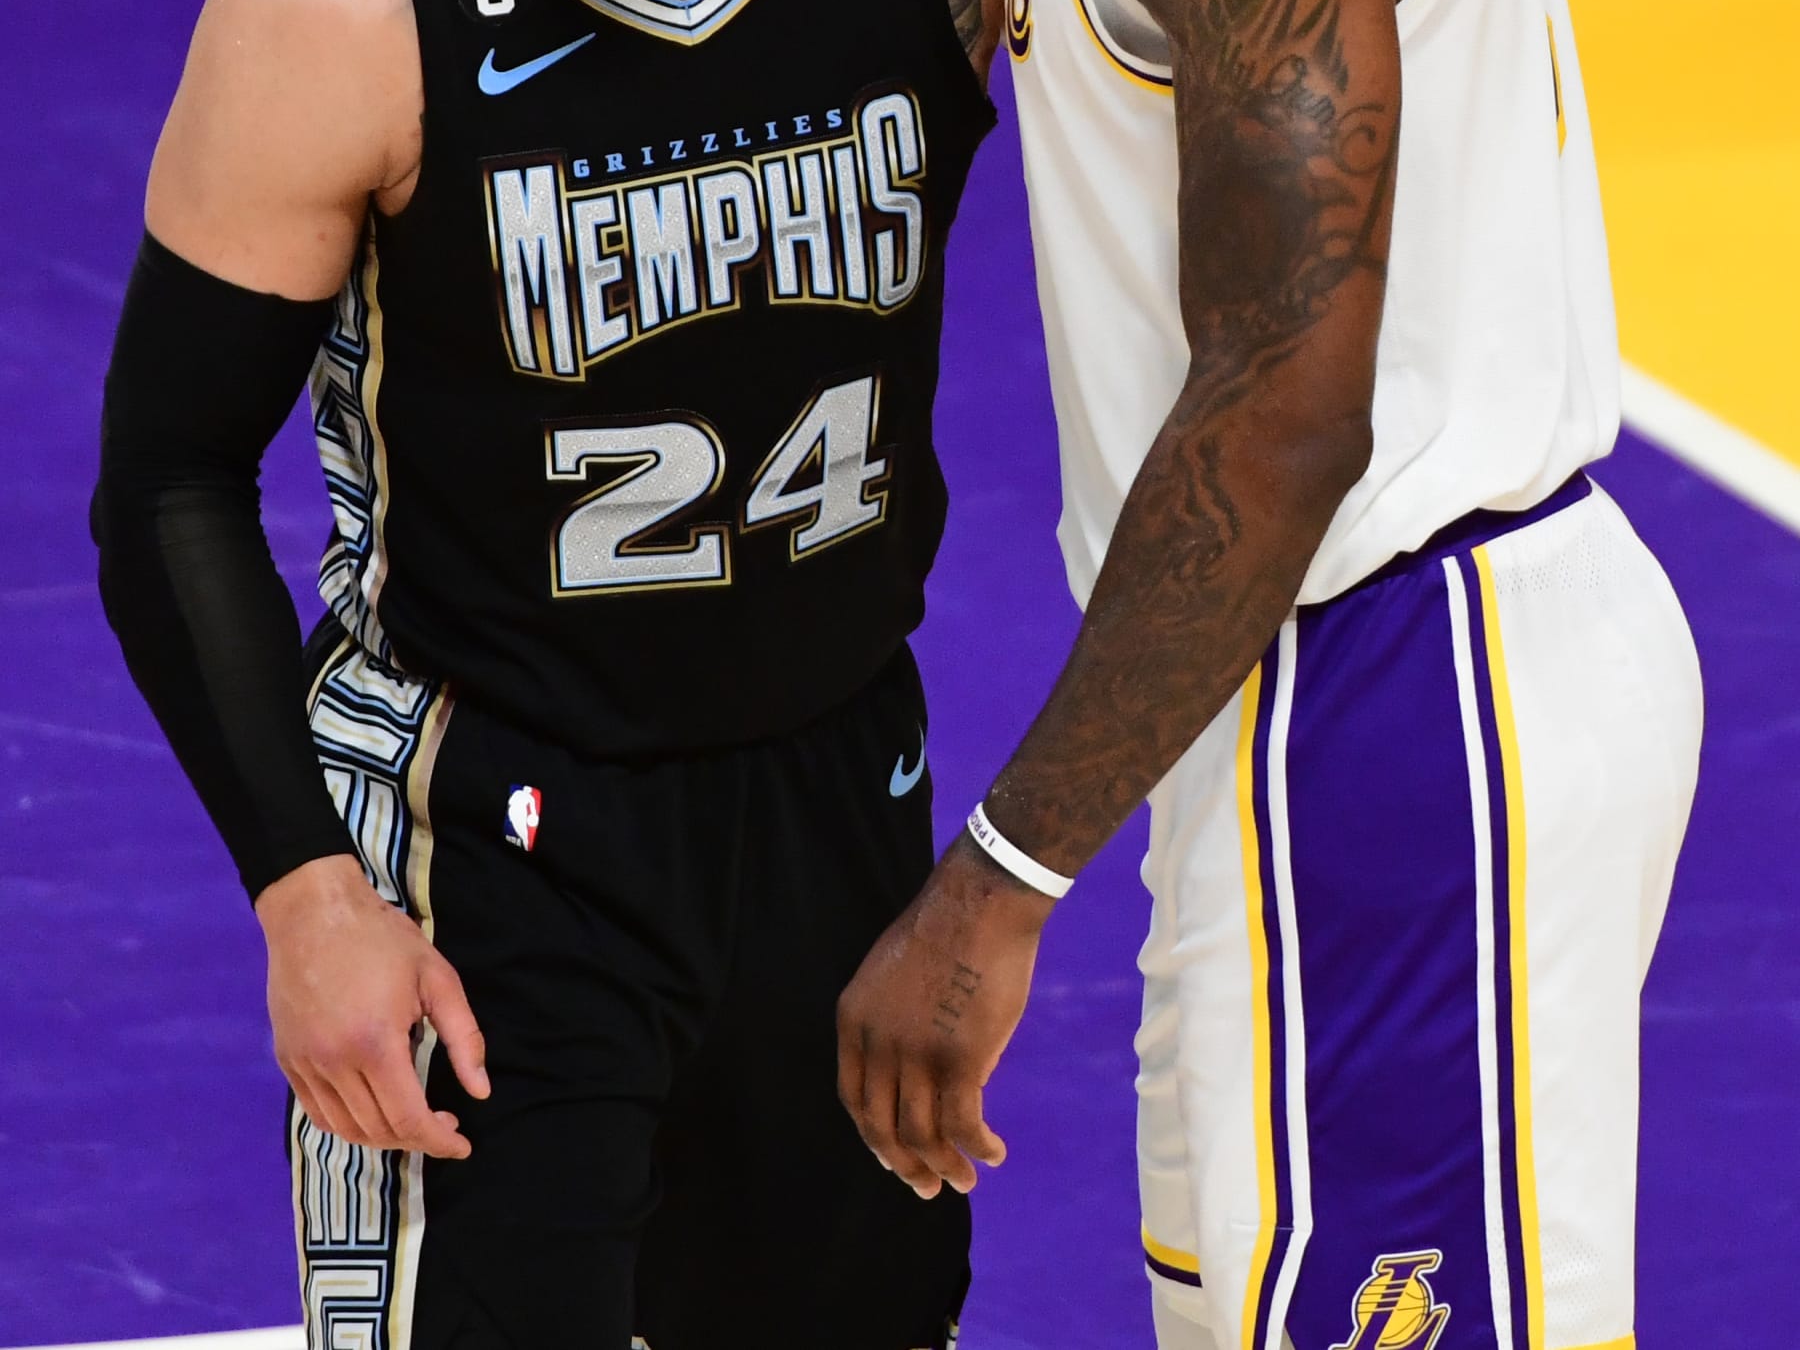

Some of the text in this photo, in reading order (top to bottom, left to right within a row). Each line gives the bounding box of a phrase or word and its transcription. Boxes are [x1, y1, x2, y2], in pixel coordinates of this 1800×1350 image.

[487, 89, 927, 381] MEMPHIS
[571, 106, 844, 180] GRIZZLIES
[545, 373, 892, 598] 24
